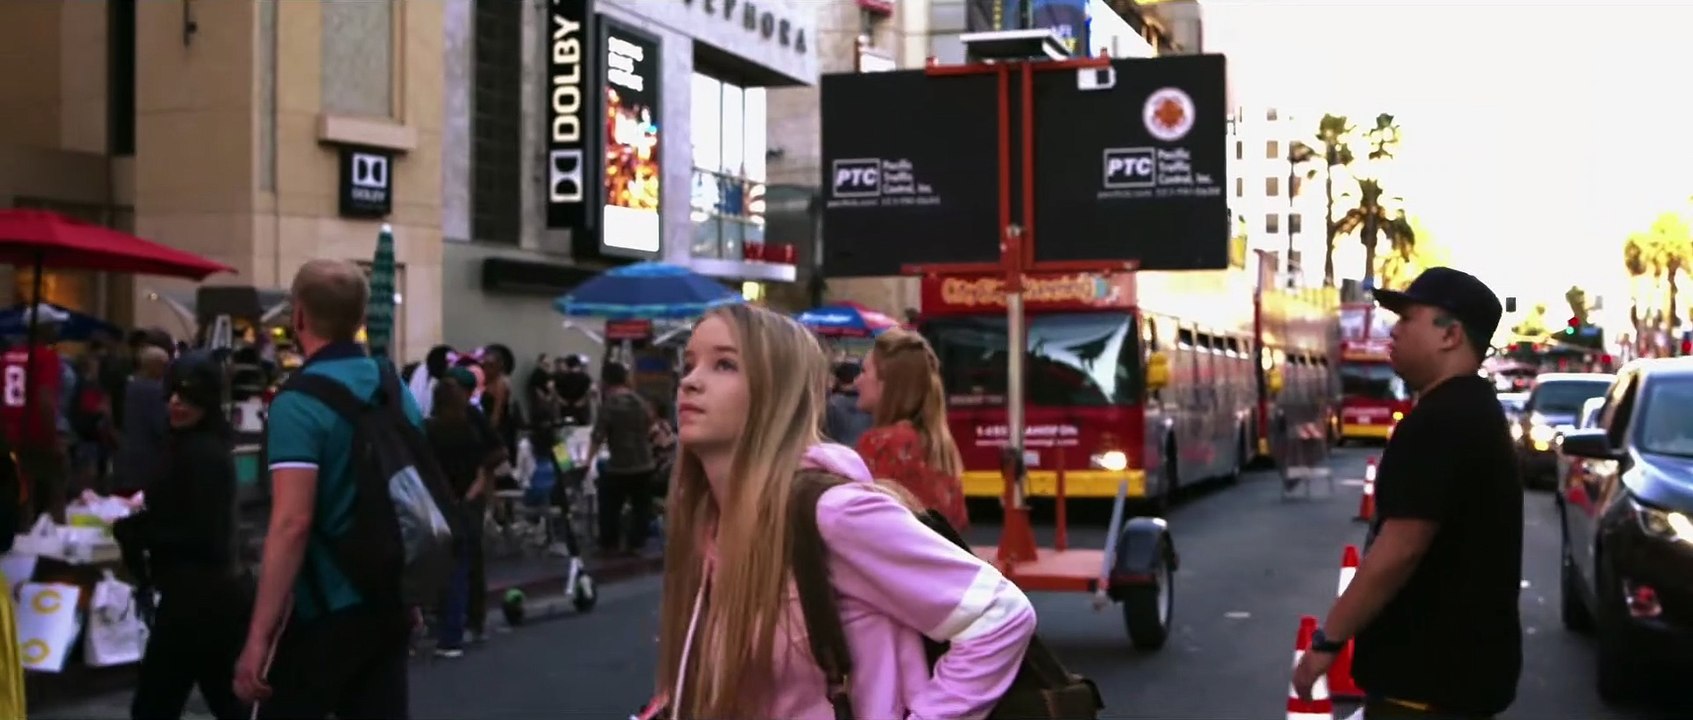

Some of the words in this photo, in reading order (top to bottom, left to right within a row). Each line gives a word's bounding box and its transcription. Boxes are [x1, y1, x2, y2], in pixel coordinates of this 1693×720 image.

[553, 14, 581, 143] DOLBY
[1108, 157, 1152, 177] PTC
[836, 168, 879, 187] PTC
